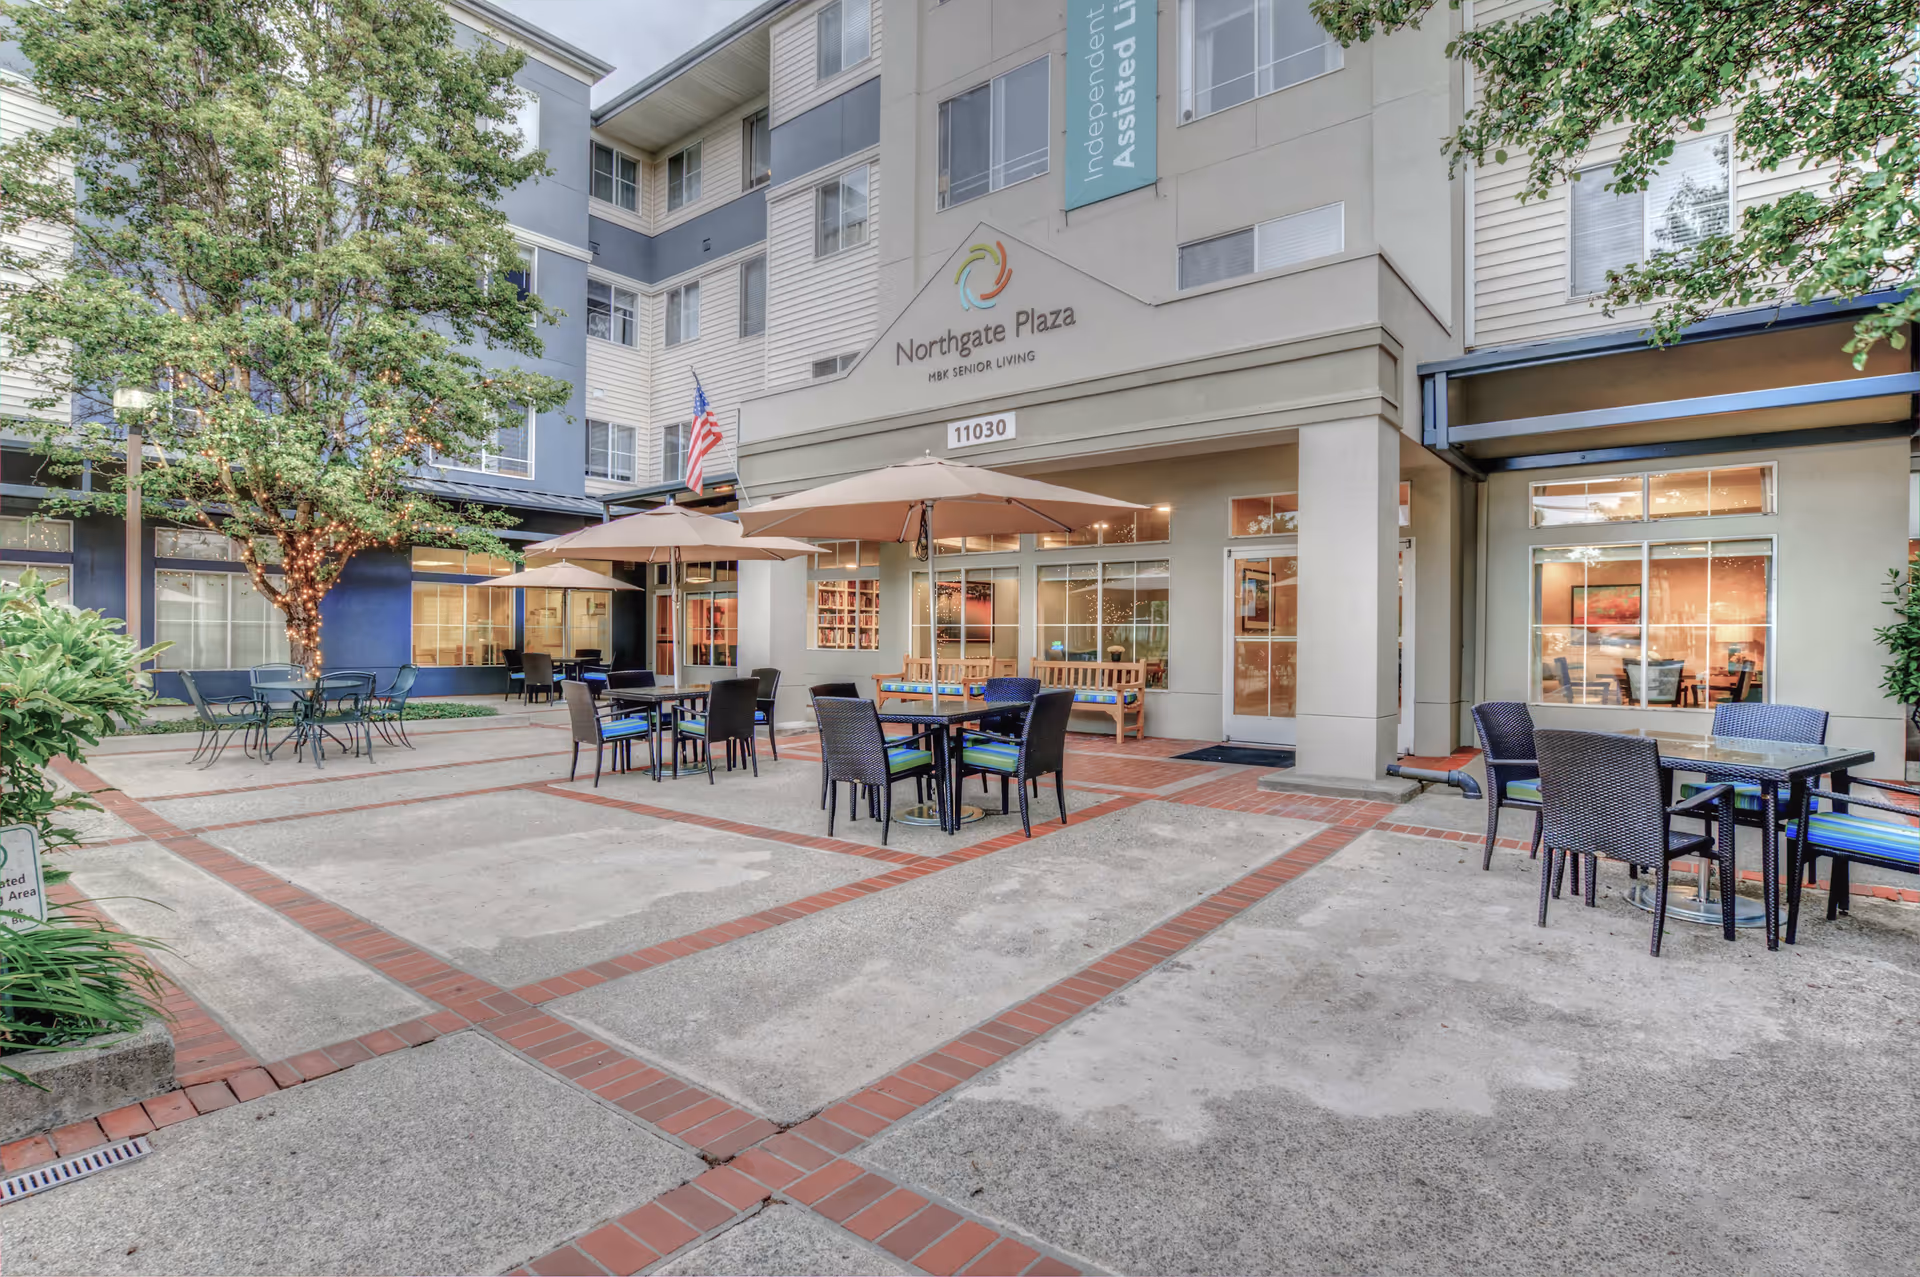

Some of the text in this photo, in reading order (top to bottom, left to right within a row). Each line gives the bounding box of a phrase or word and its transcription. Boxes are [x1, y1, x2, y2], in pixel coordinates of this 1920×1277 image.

[1084, 3, 1108, 182] Independent
[1112, 0, 1136, 168] Assisted Li
[896, 306, 1076, 366] Northgate Plaza
[928, 350, 1036, 382] MBK SENIOR LIVING
[954, 418, 1007, 443] 11030
[8, 888, 36, 901] Area
